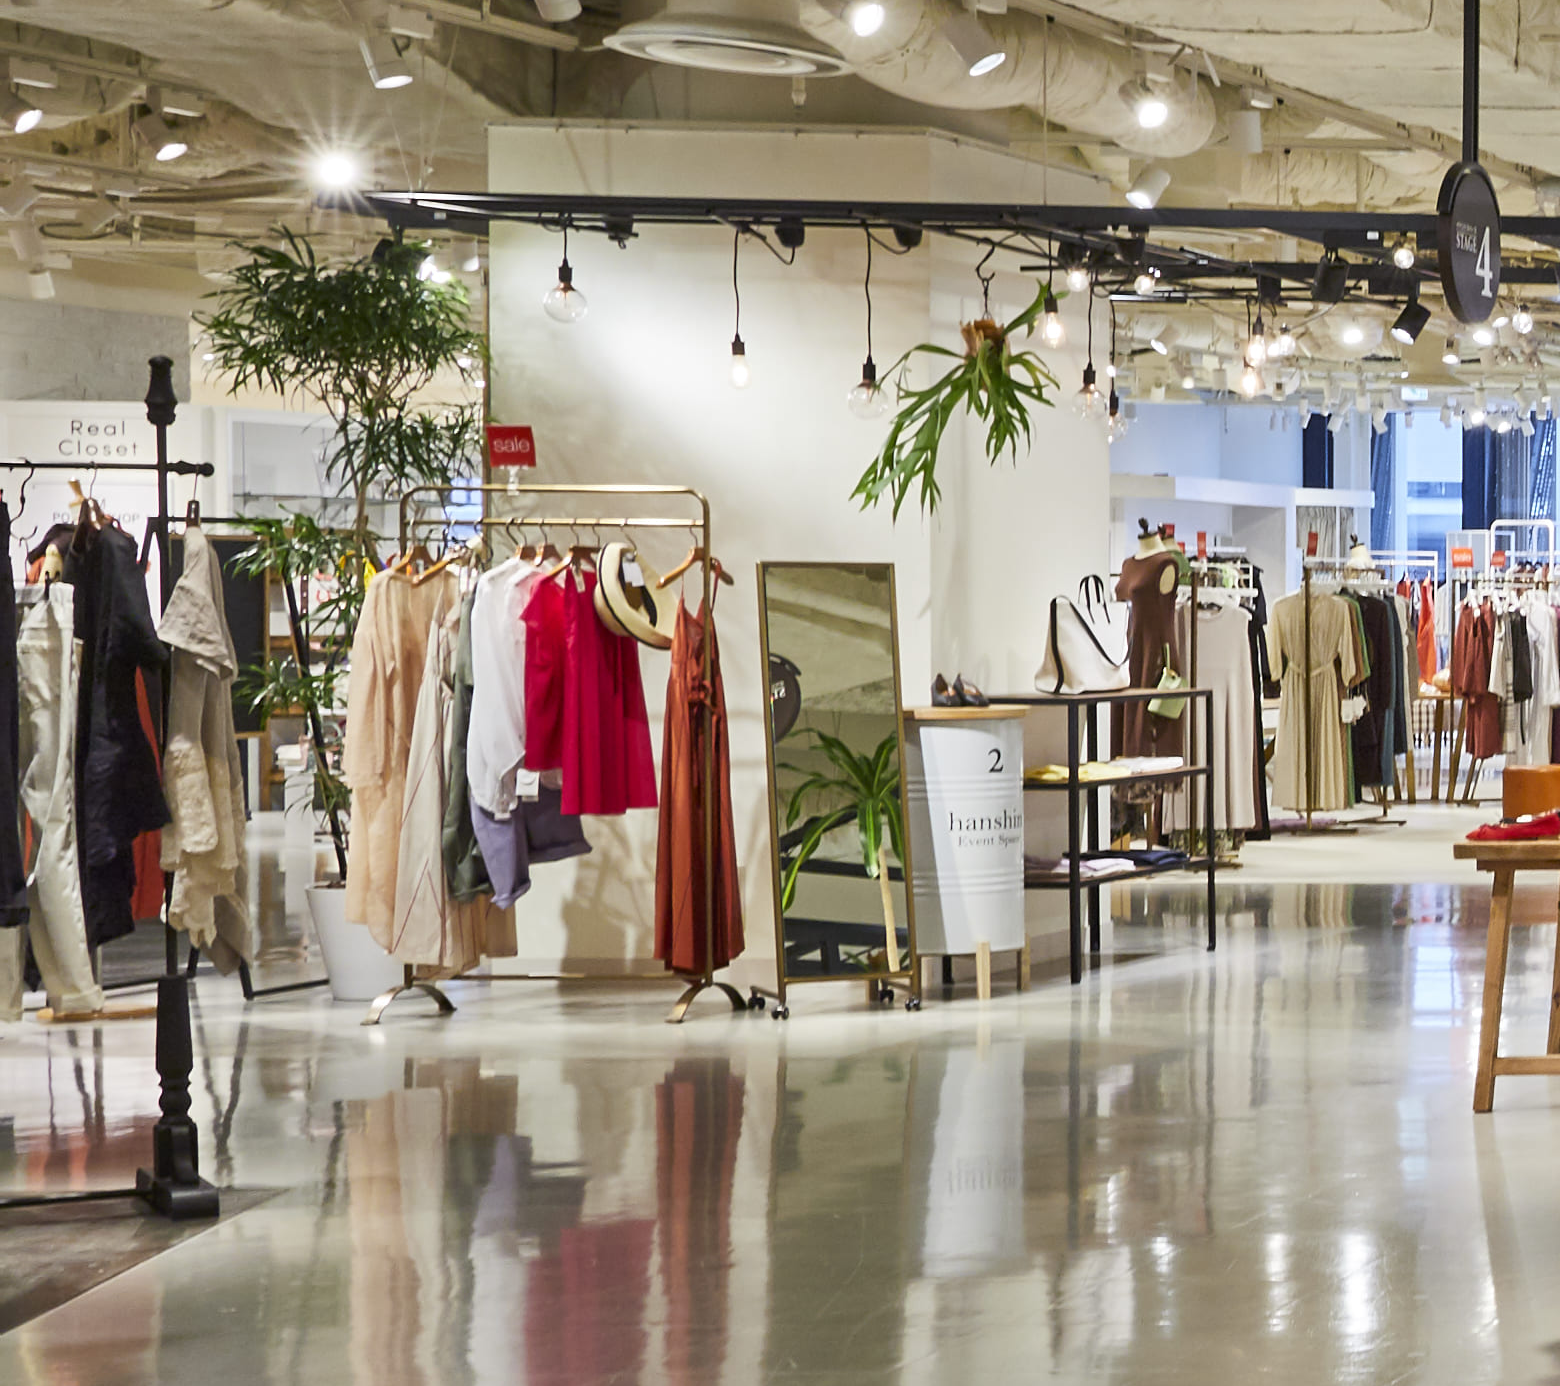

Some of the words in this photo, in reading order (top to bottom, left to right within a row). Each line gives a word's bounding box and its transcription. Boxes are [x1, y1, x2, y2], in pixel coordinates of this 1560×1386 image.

[1456, 233, 1477, 253] STAGE
[1475, 226, 1493, 298] 4
[71, 420, 126, 436] Real
[58, 439, 138, 457] Closet
[493, 435, 530, 453] sale
[987, 748, 1004, 773] 2
